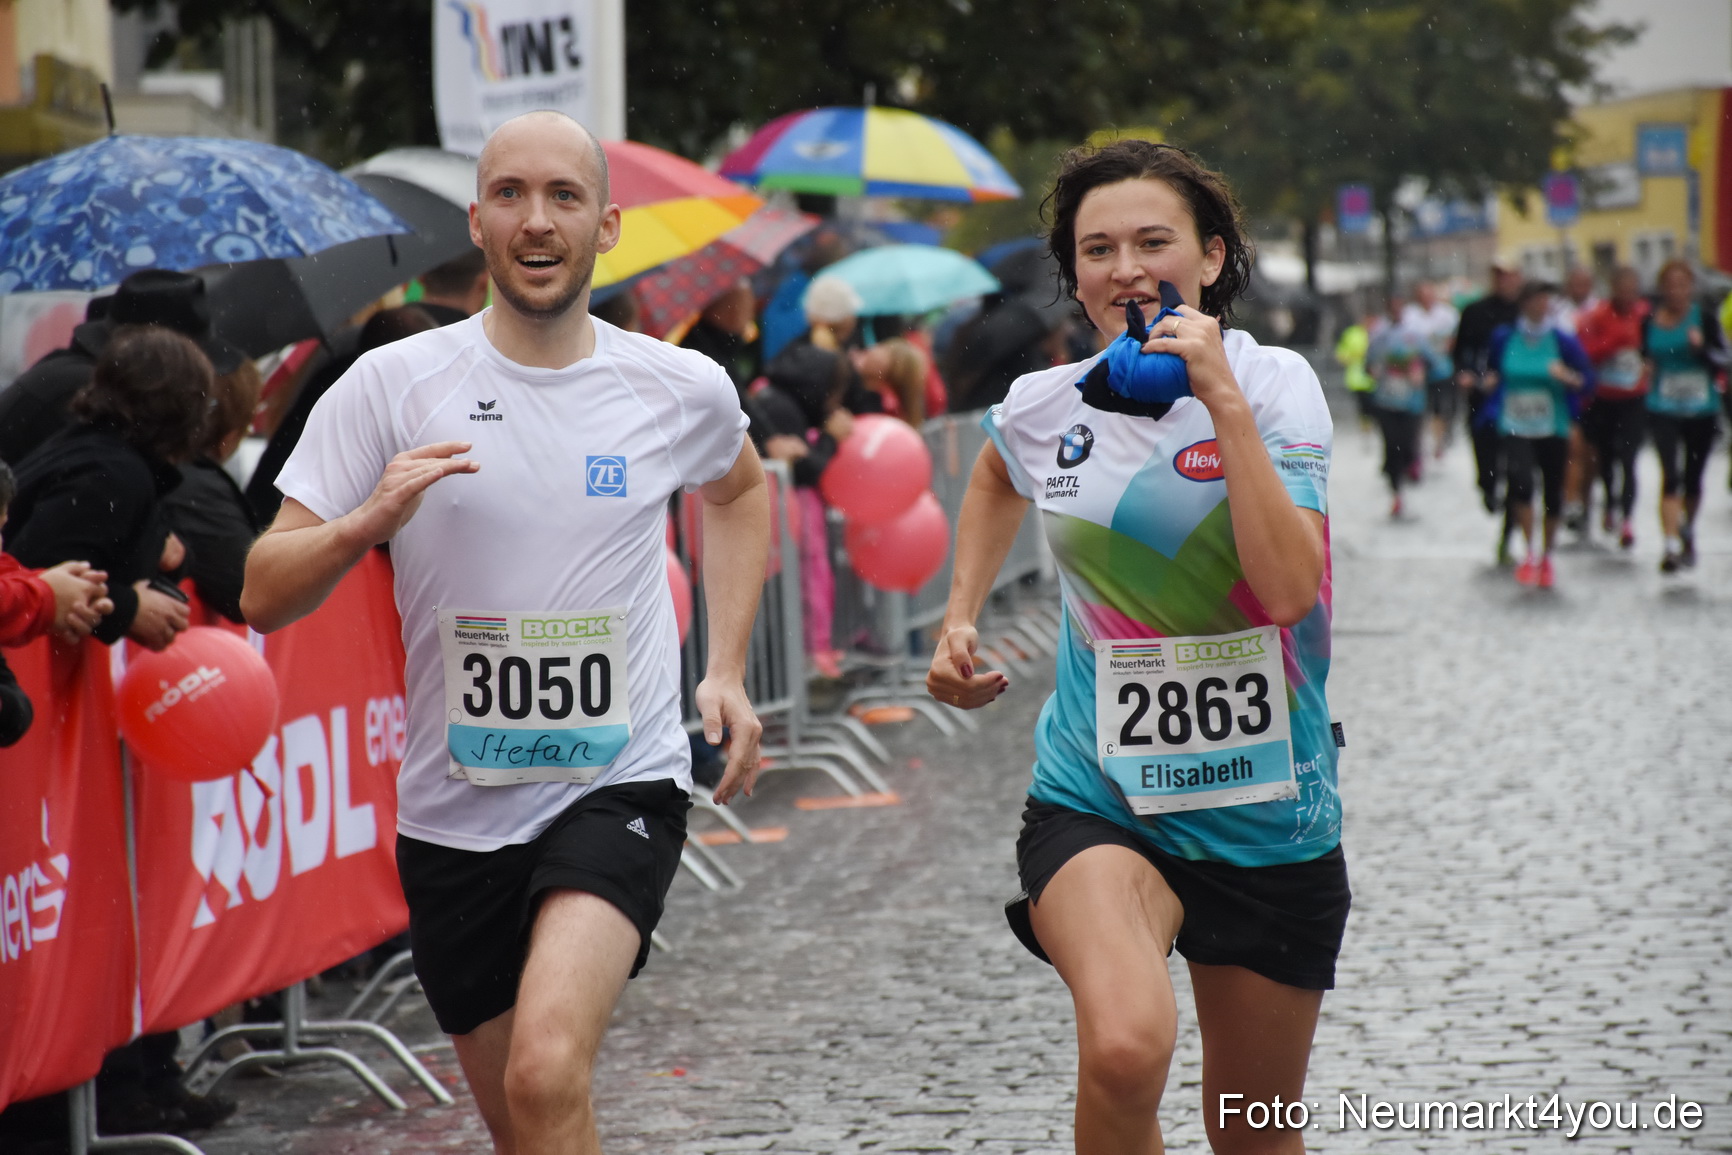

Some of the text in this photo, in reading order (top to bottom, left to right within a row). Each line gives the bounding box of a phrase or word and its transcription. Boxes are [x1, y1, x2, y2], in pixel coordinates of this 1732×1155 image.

[469, 413, 503, 422] erima
[1046, 475, 1080, 490] PARTL
[454, 629, 510, 642] NeuerMarkt
[521, 616, 612, 640] BOCK
[1174, 633, 1266, 664] BOCK
[1109, 658, 1167, 669] NeuerMarkt
[1216, 660, 1237, 668] smart
[463, 652, 611, 720] 3050
[1117, 672, 1272, 747] 2863
[471, 733, 594, 767] Stefan
[1106, 743, 1114, 755] C
[1140, 755, 1254, 790] Elisabeth
